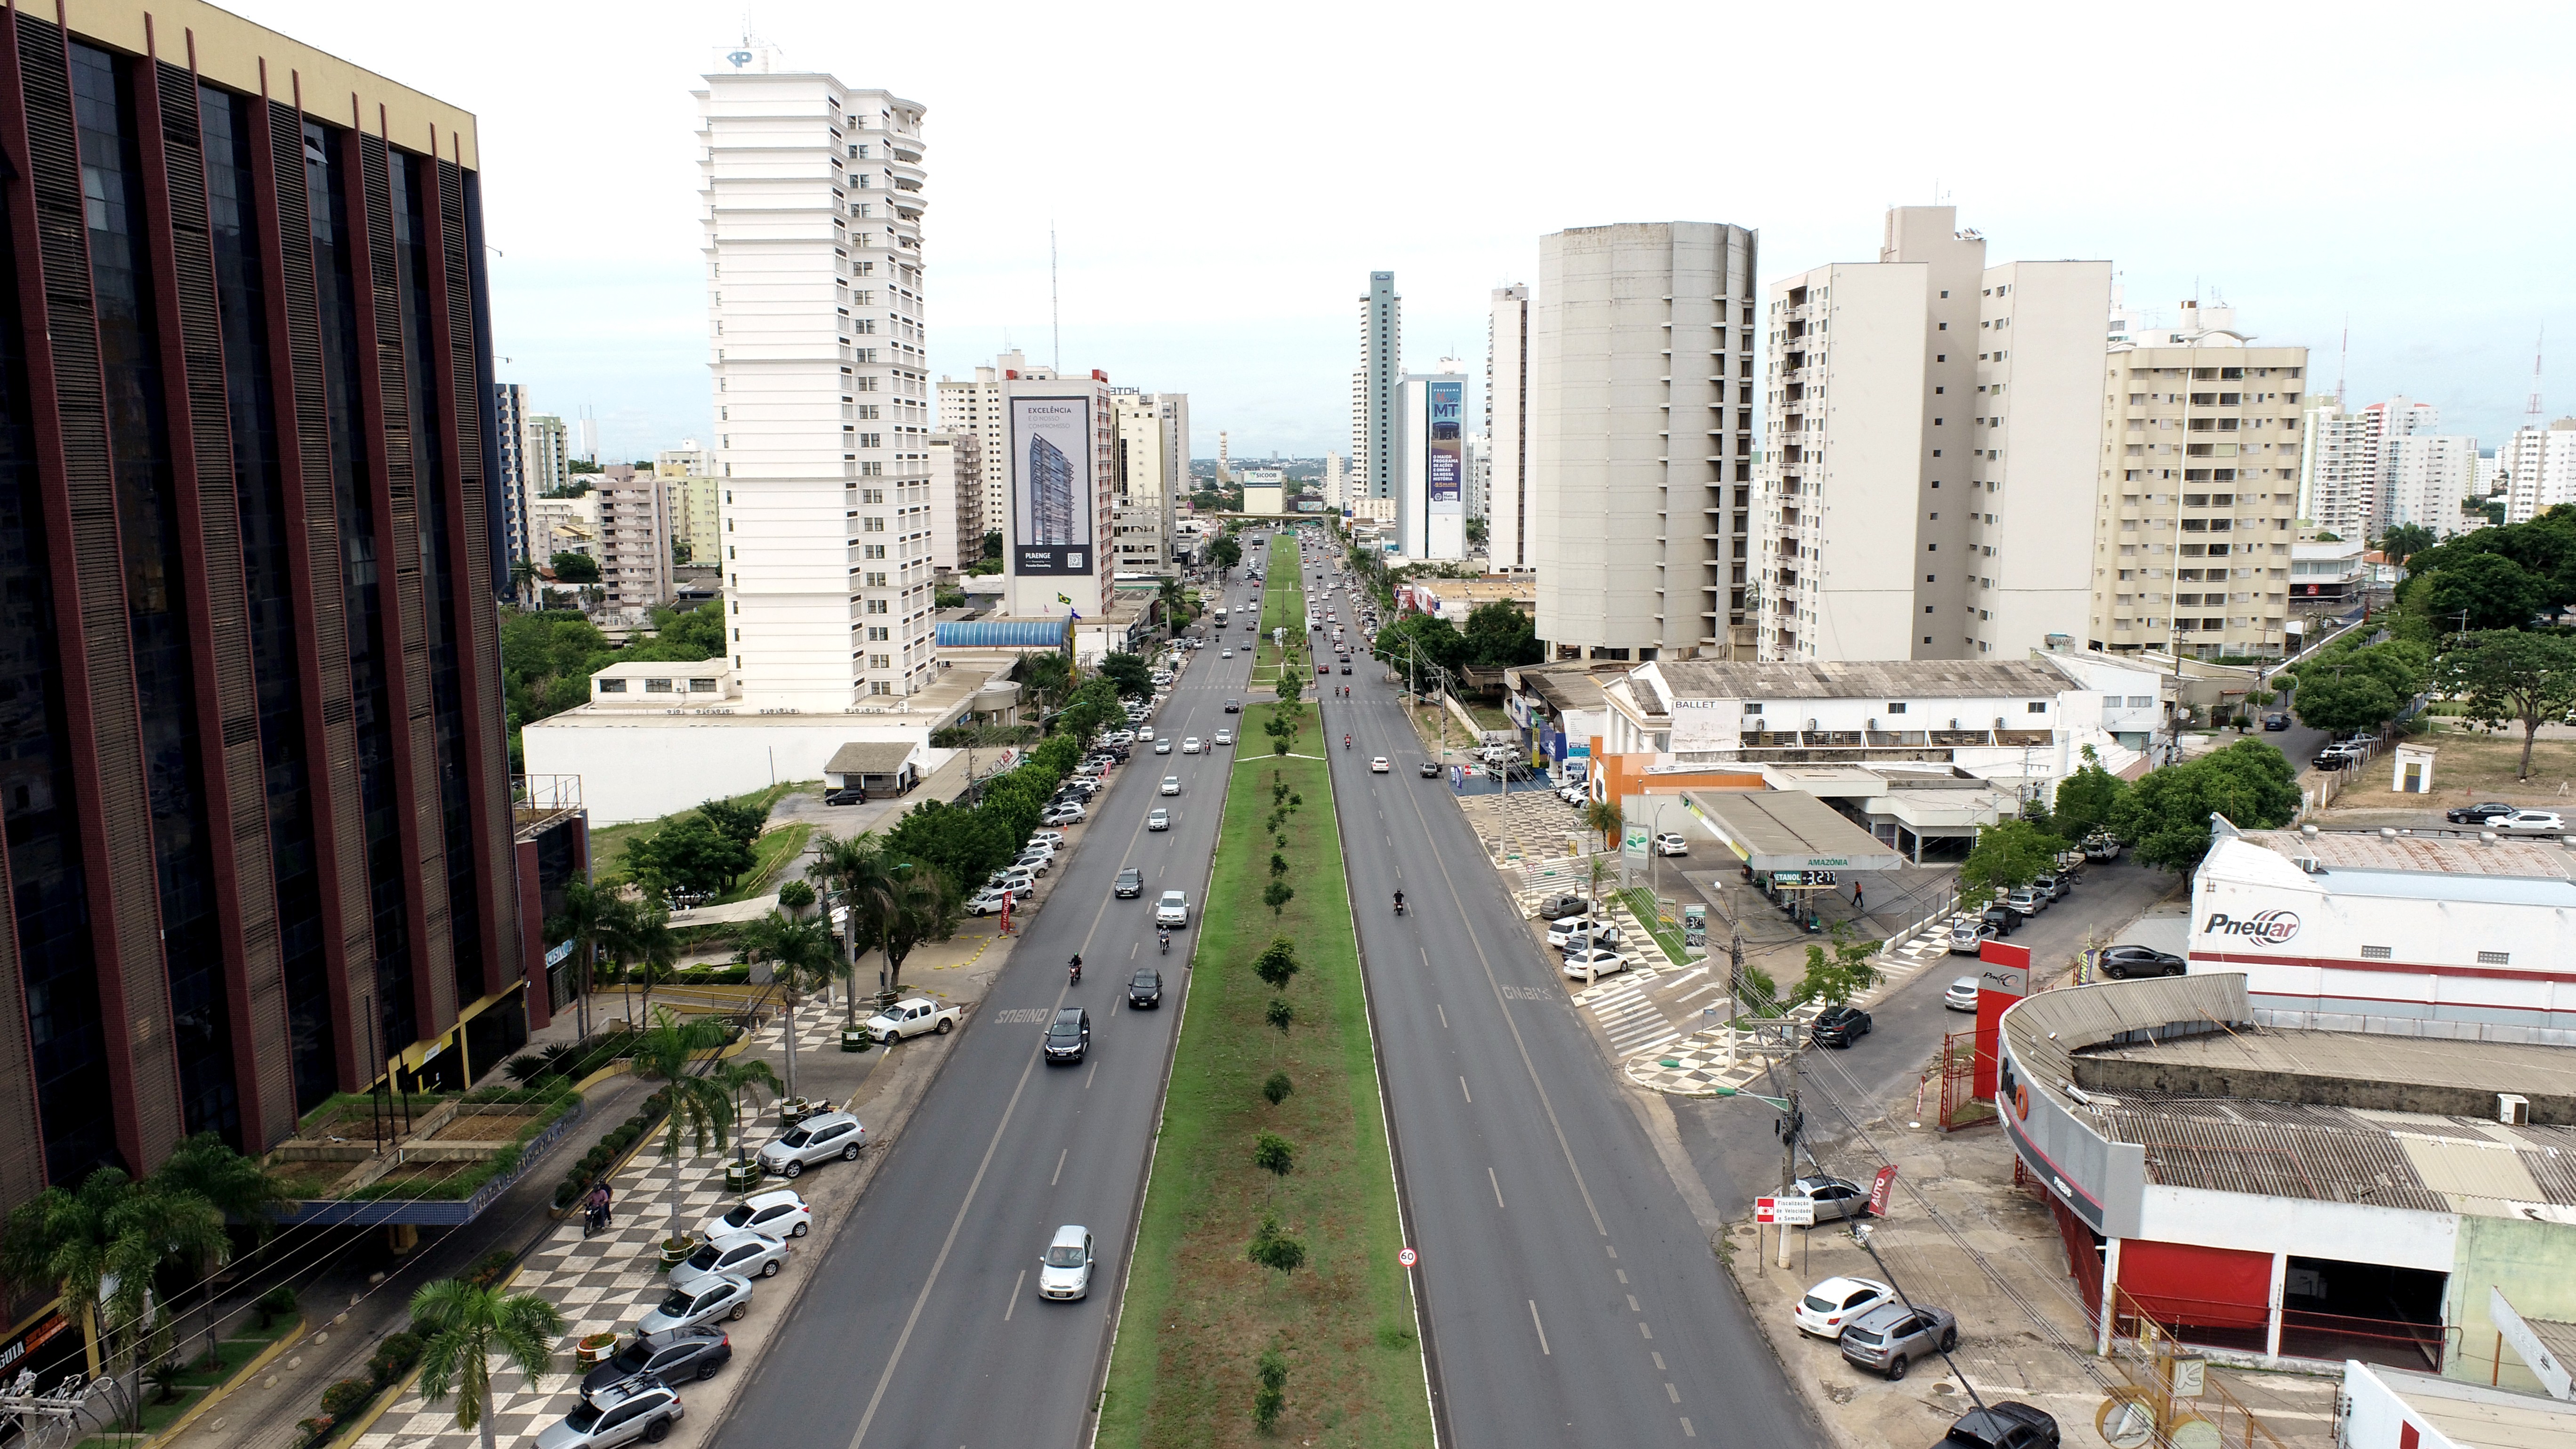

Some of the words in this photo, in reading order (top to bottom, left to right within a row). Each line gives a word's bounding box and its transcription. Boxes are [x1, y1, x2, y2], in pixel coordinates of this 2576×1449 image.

[1435, 392, 1458, 403] Mais
[1434, 404, 1458, 417] MT
[2204, 914, 2297, 937] Pneuar
[1871, 1177, 1885, 1207] AUTO
[1401, 1252, 1413, 1260] 60
